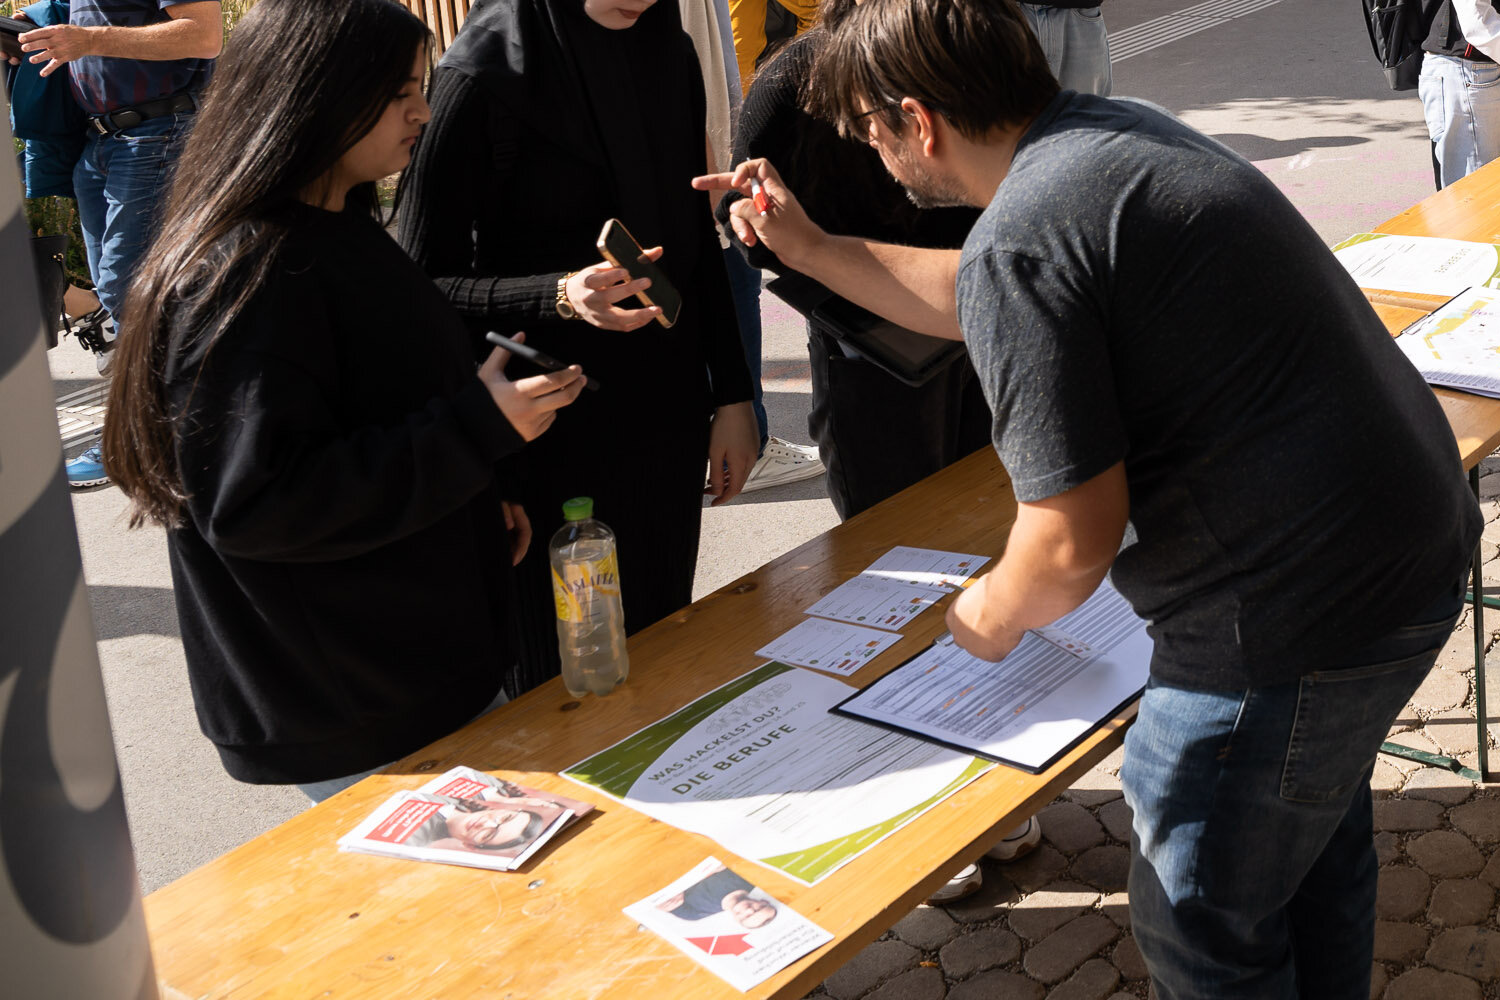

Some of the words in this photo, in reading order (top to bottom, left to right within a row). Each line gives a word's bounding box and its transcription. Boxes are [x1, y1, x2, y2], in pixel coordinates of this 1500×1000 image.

[648, 762, 684, 782] WAS
[684, 722, 752, 763] HACKELST
[753, 706, 782, 724] DU?
[672, 771, 714, 795] DIE
[713, 724, 797, 771] BERUFE
